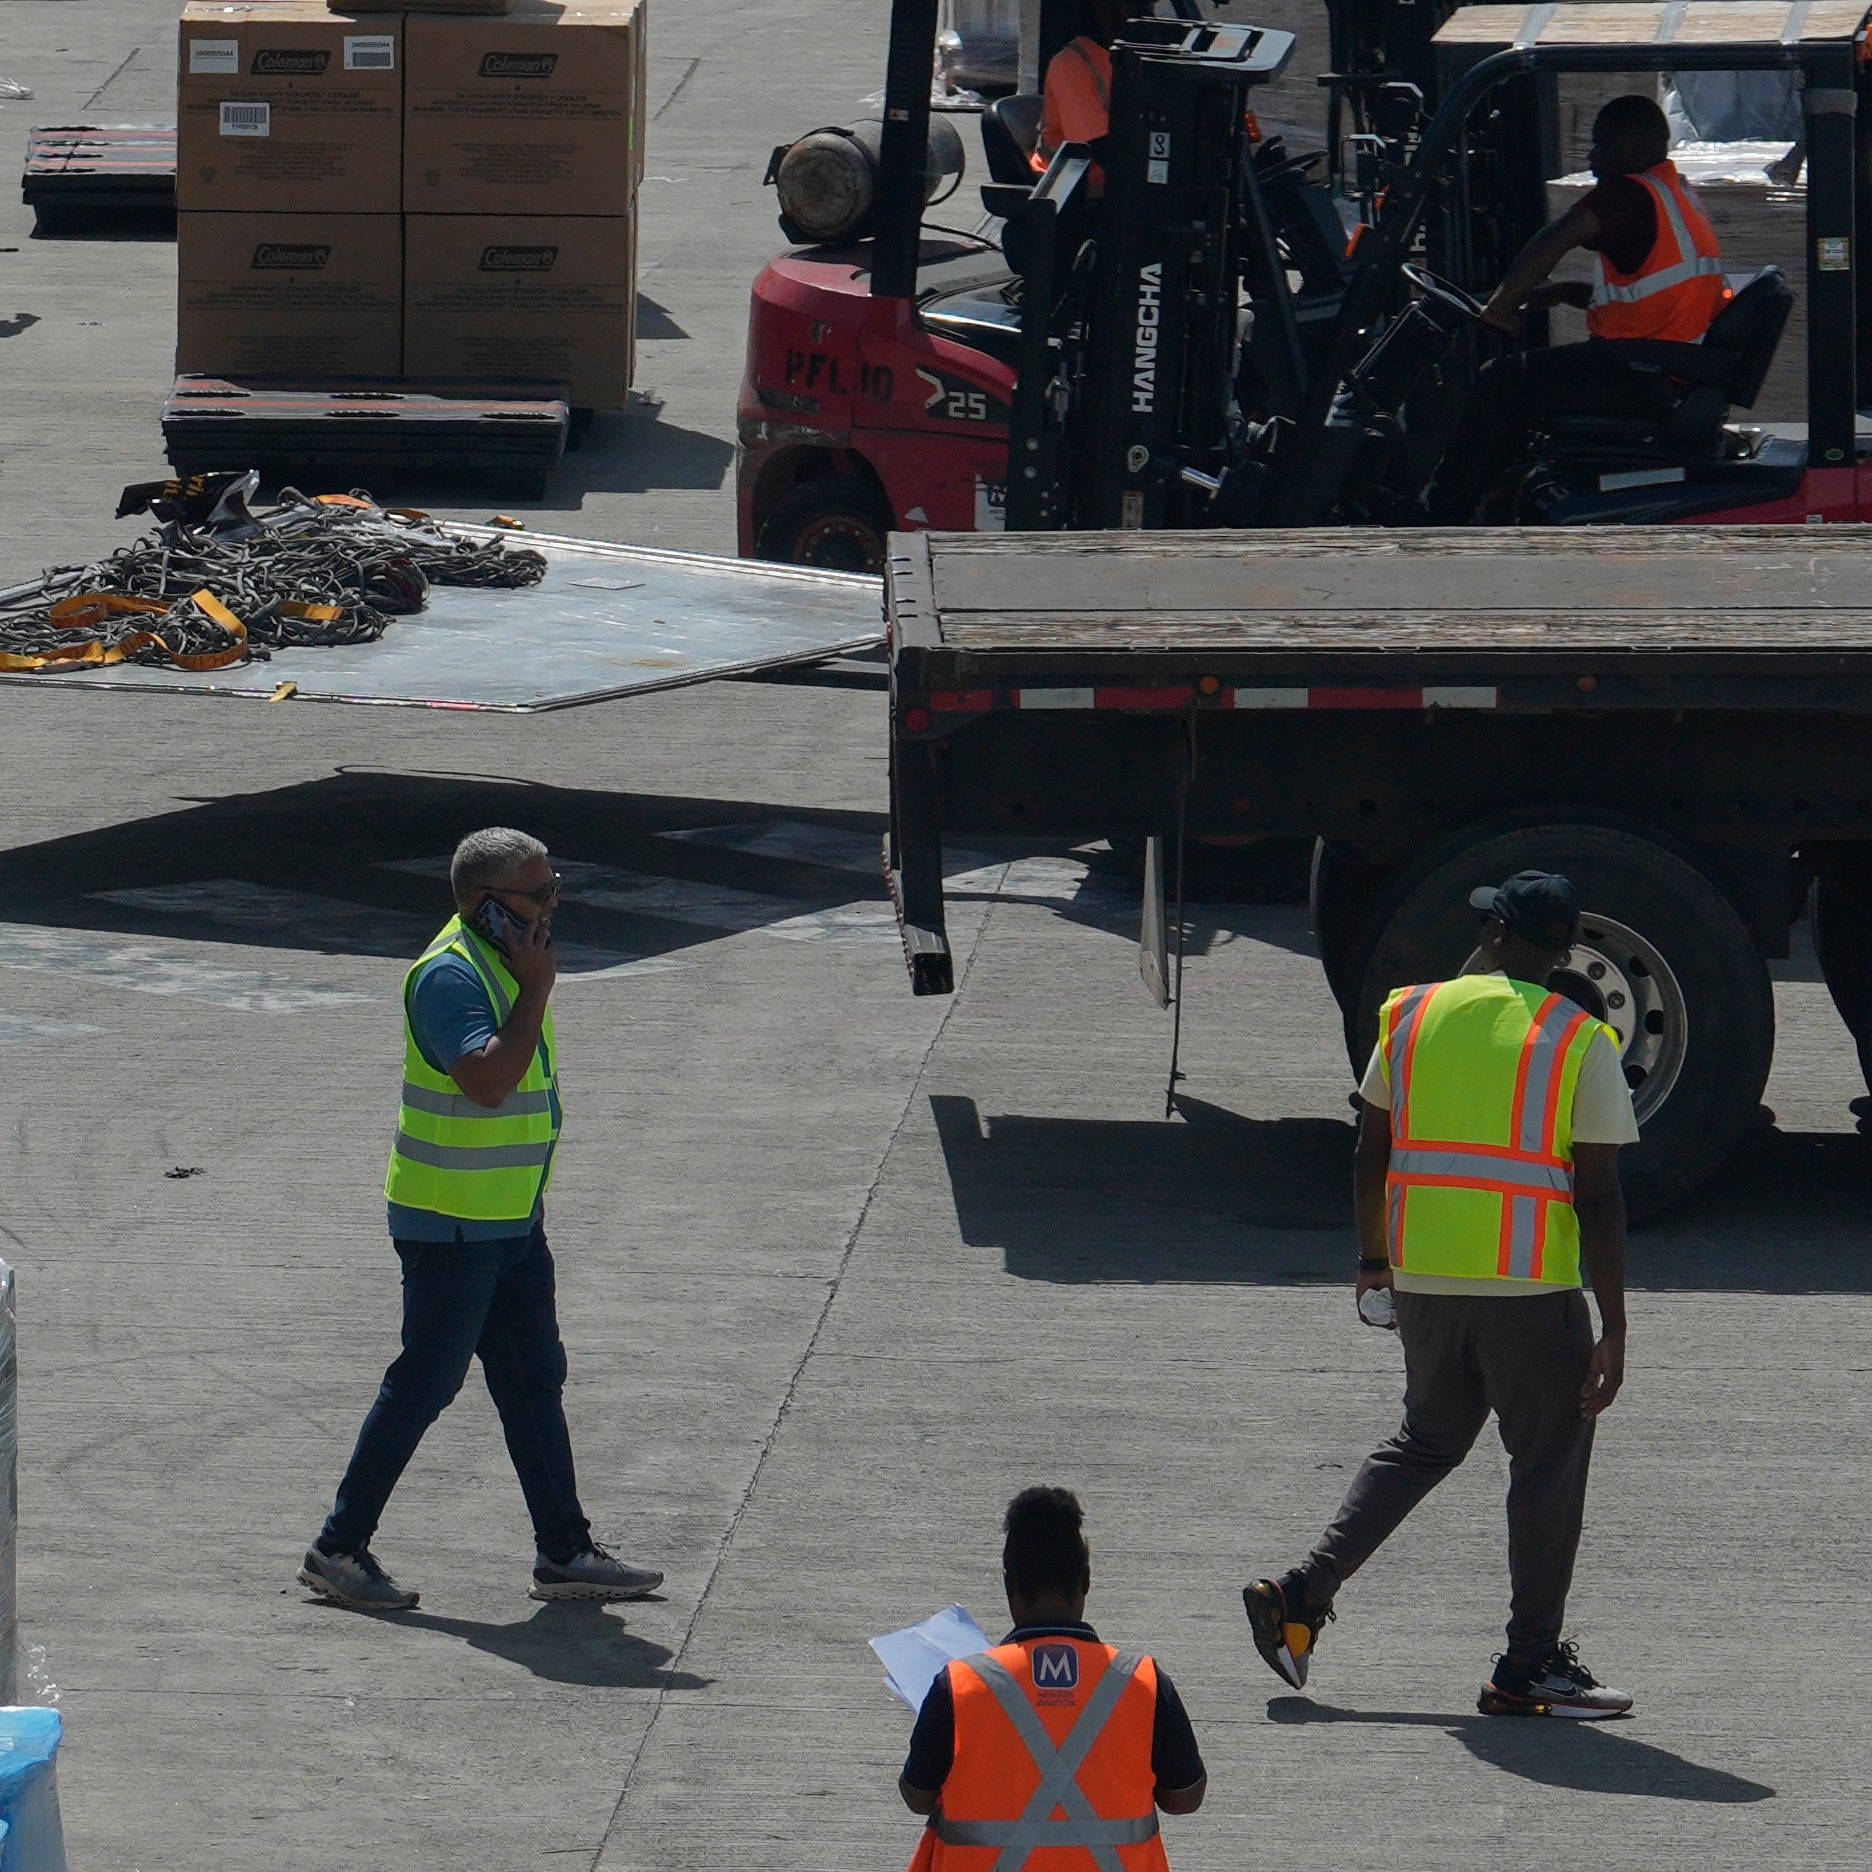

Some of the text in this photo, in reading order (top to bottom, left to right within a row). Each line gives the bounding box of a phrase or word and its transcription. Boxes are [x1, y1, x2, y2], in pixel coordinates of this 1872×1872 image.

[257, 52, 313, 69] Coleman
[484, 55, 542, 72] Coleman
[257, 246, 316, 264] Coleman
[485, 249, 543, 267] Coleman
[1132, 262, 1162, 413] HANGCHA
[785, 348, 848, 395] PFL
[947, 392, 987, 420] 25
[1039, 1651, 1073, 1681] M
